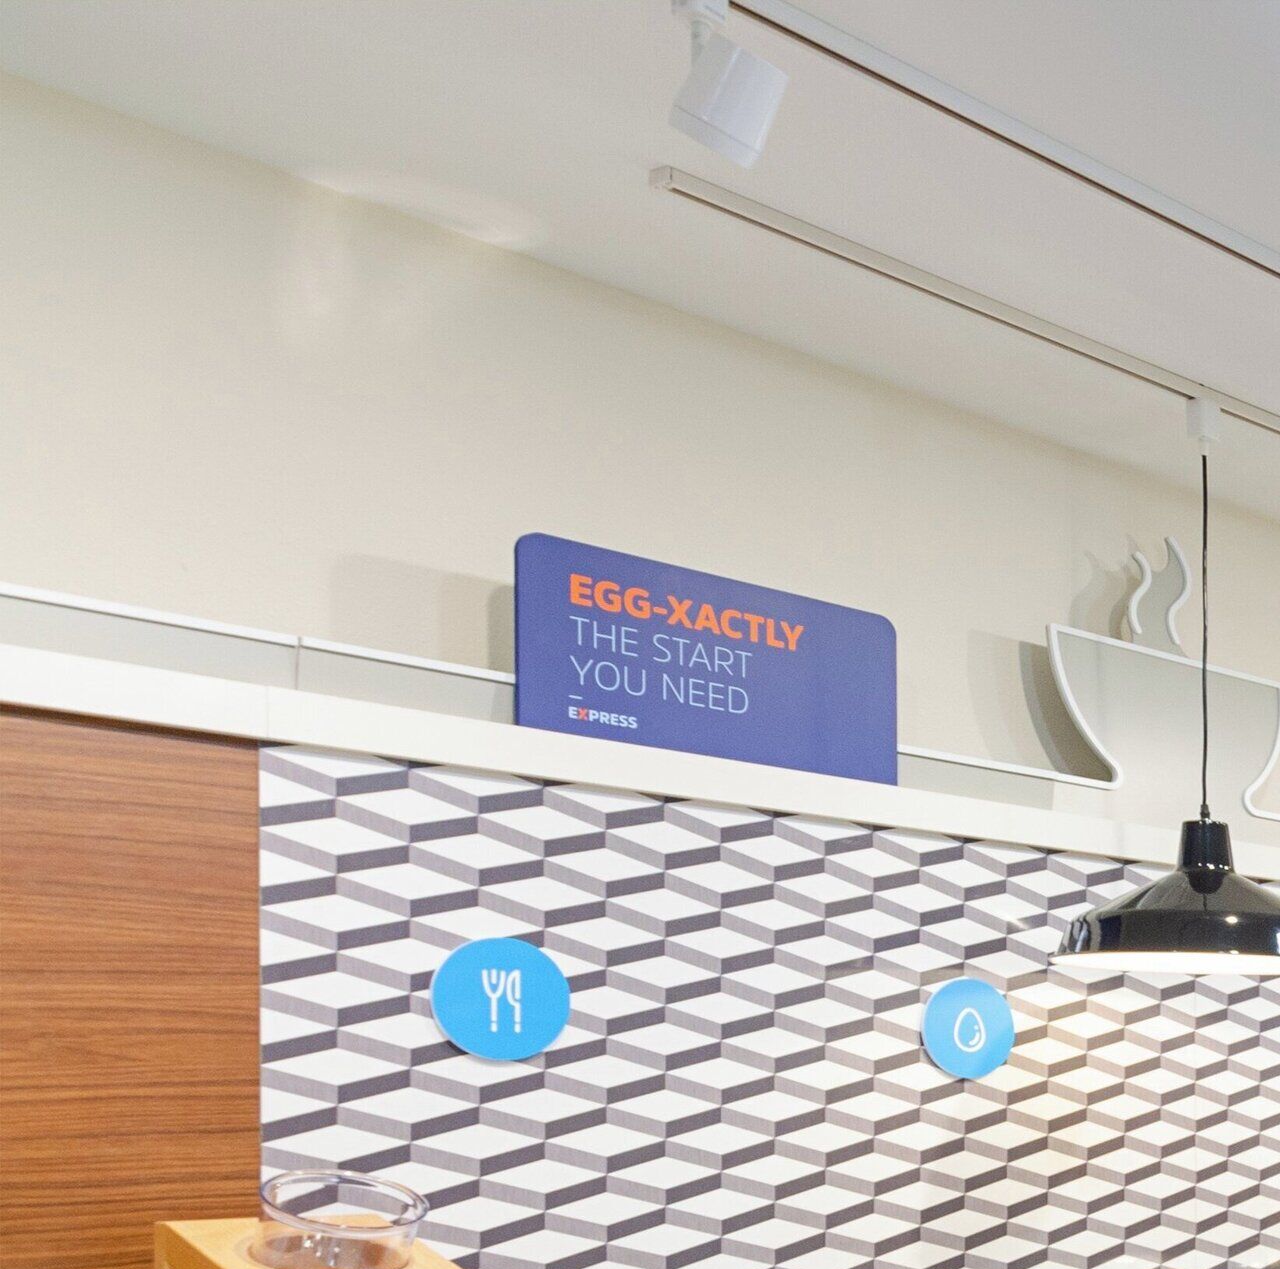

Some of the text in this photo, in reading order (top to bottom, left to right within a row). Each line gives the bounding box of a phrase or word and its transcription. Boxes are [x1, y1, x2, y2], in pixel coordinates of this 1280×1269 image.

[570, 573, 804, 651] EGG-XACTLY
[569, 615, 752, 678] THE START
[570, 655, 749, 713] YOU NEED
[568, 706, 638, 729] EXPRESS
